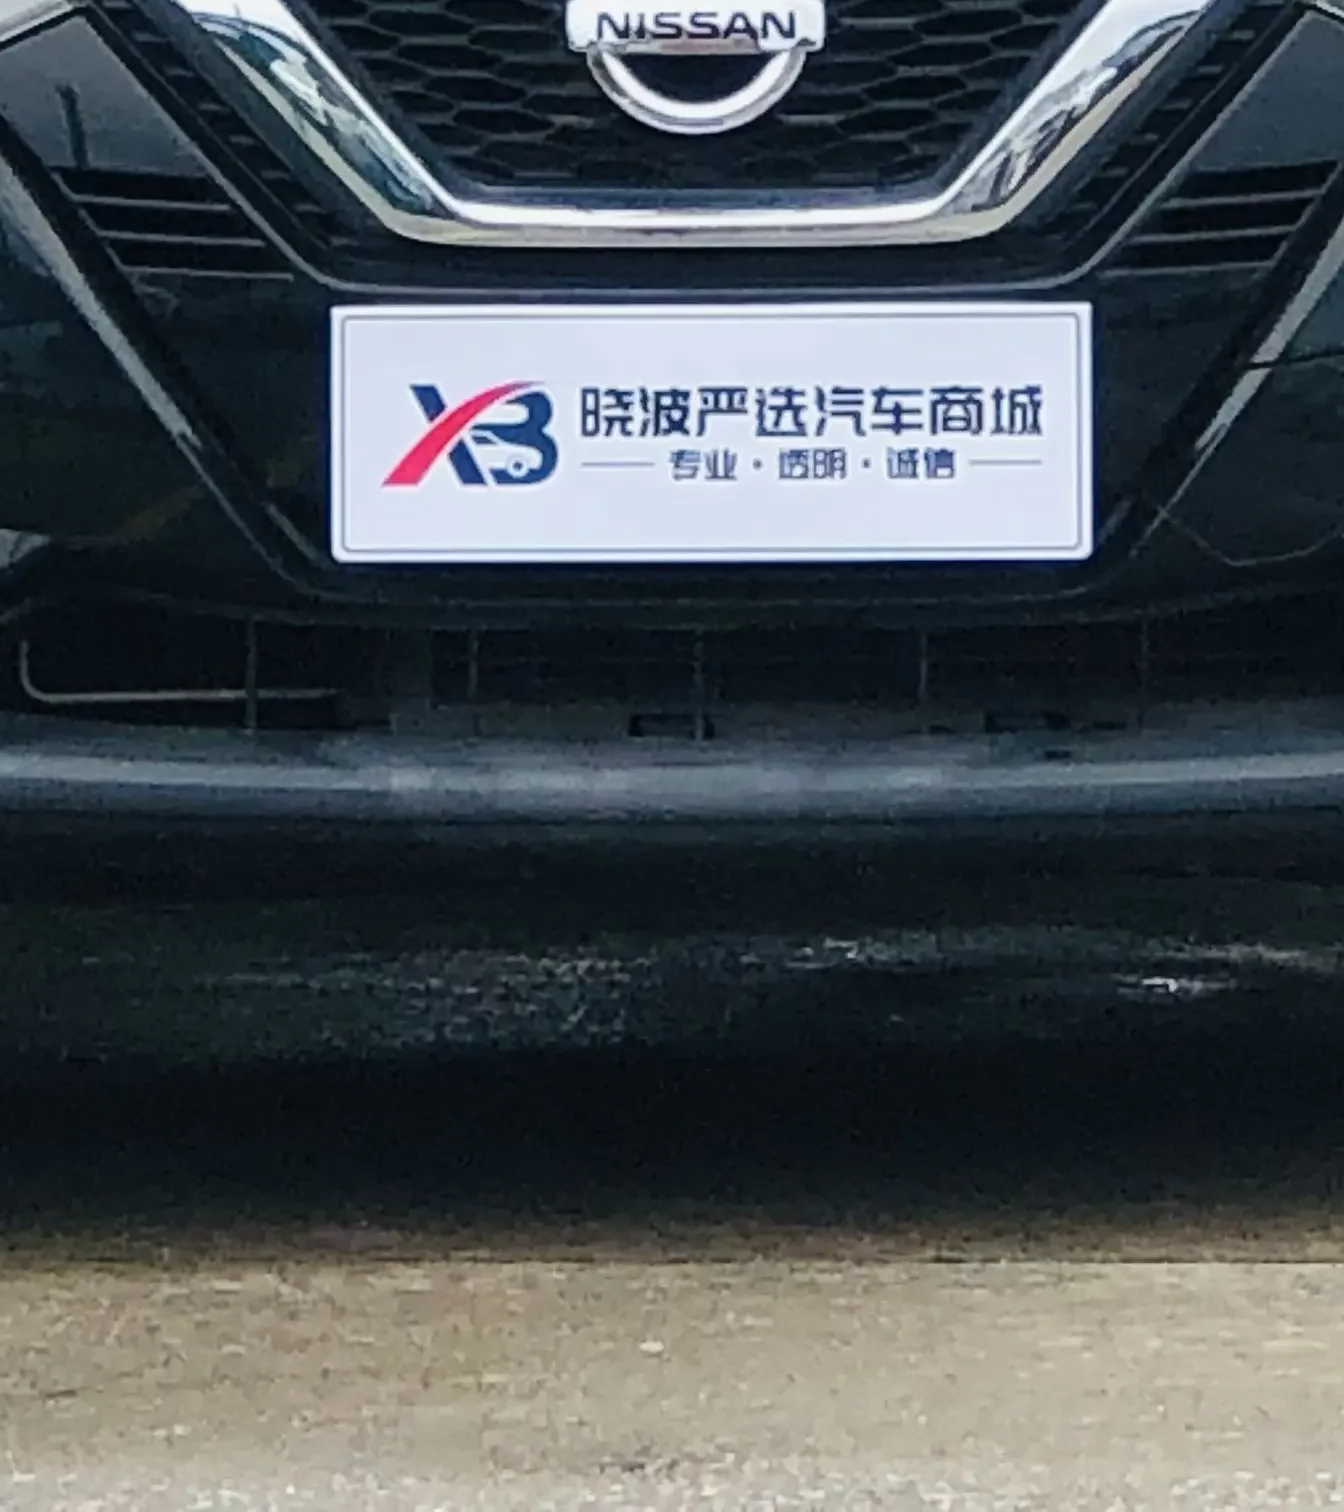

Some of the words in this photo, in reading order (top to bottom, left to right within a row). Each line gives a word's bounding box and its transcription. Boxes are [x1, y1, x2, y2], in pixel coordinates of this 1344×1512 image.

[597, 11, 796, 39] NISSAN
[581, 386, 1042, 438] 晓波严选汽车商城
